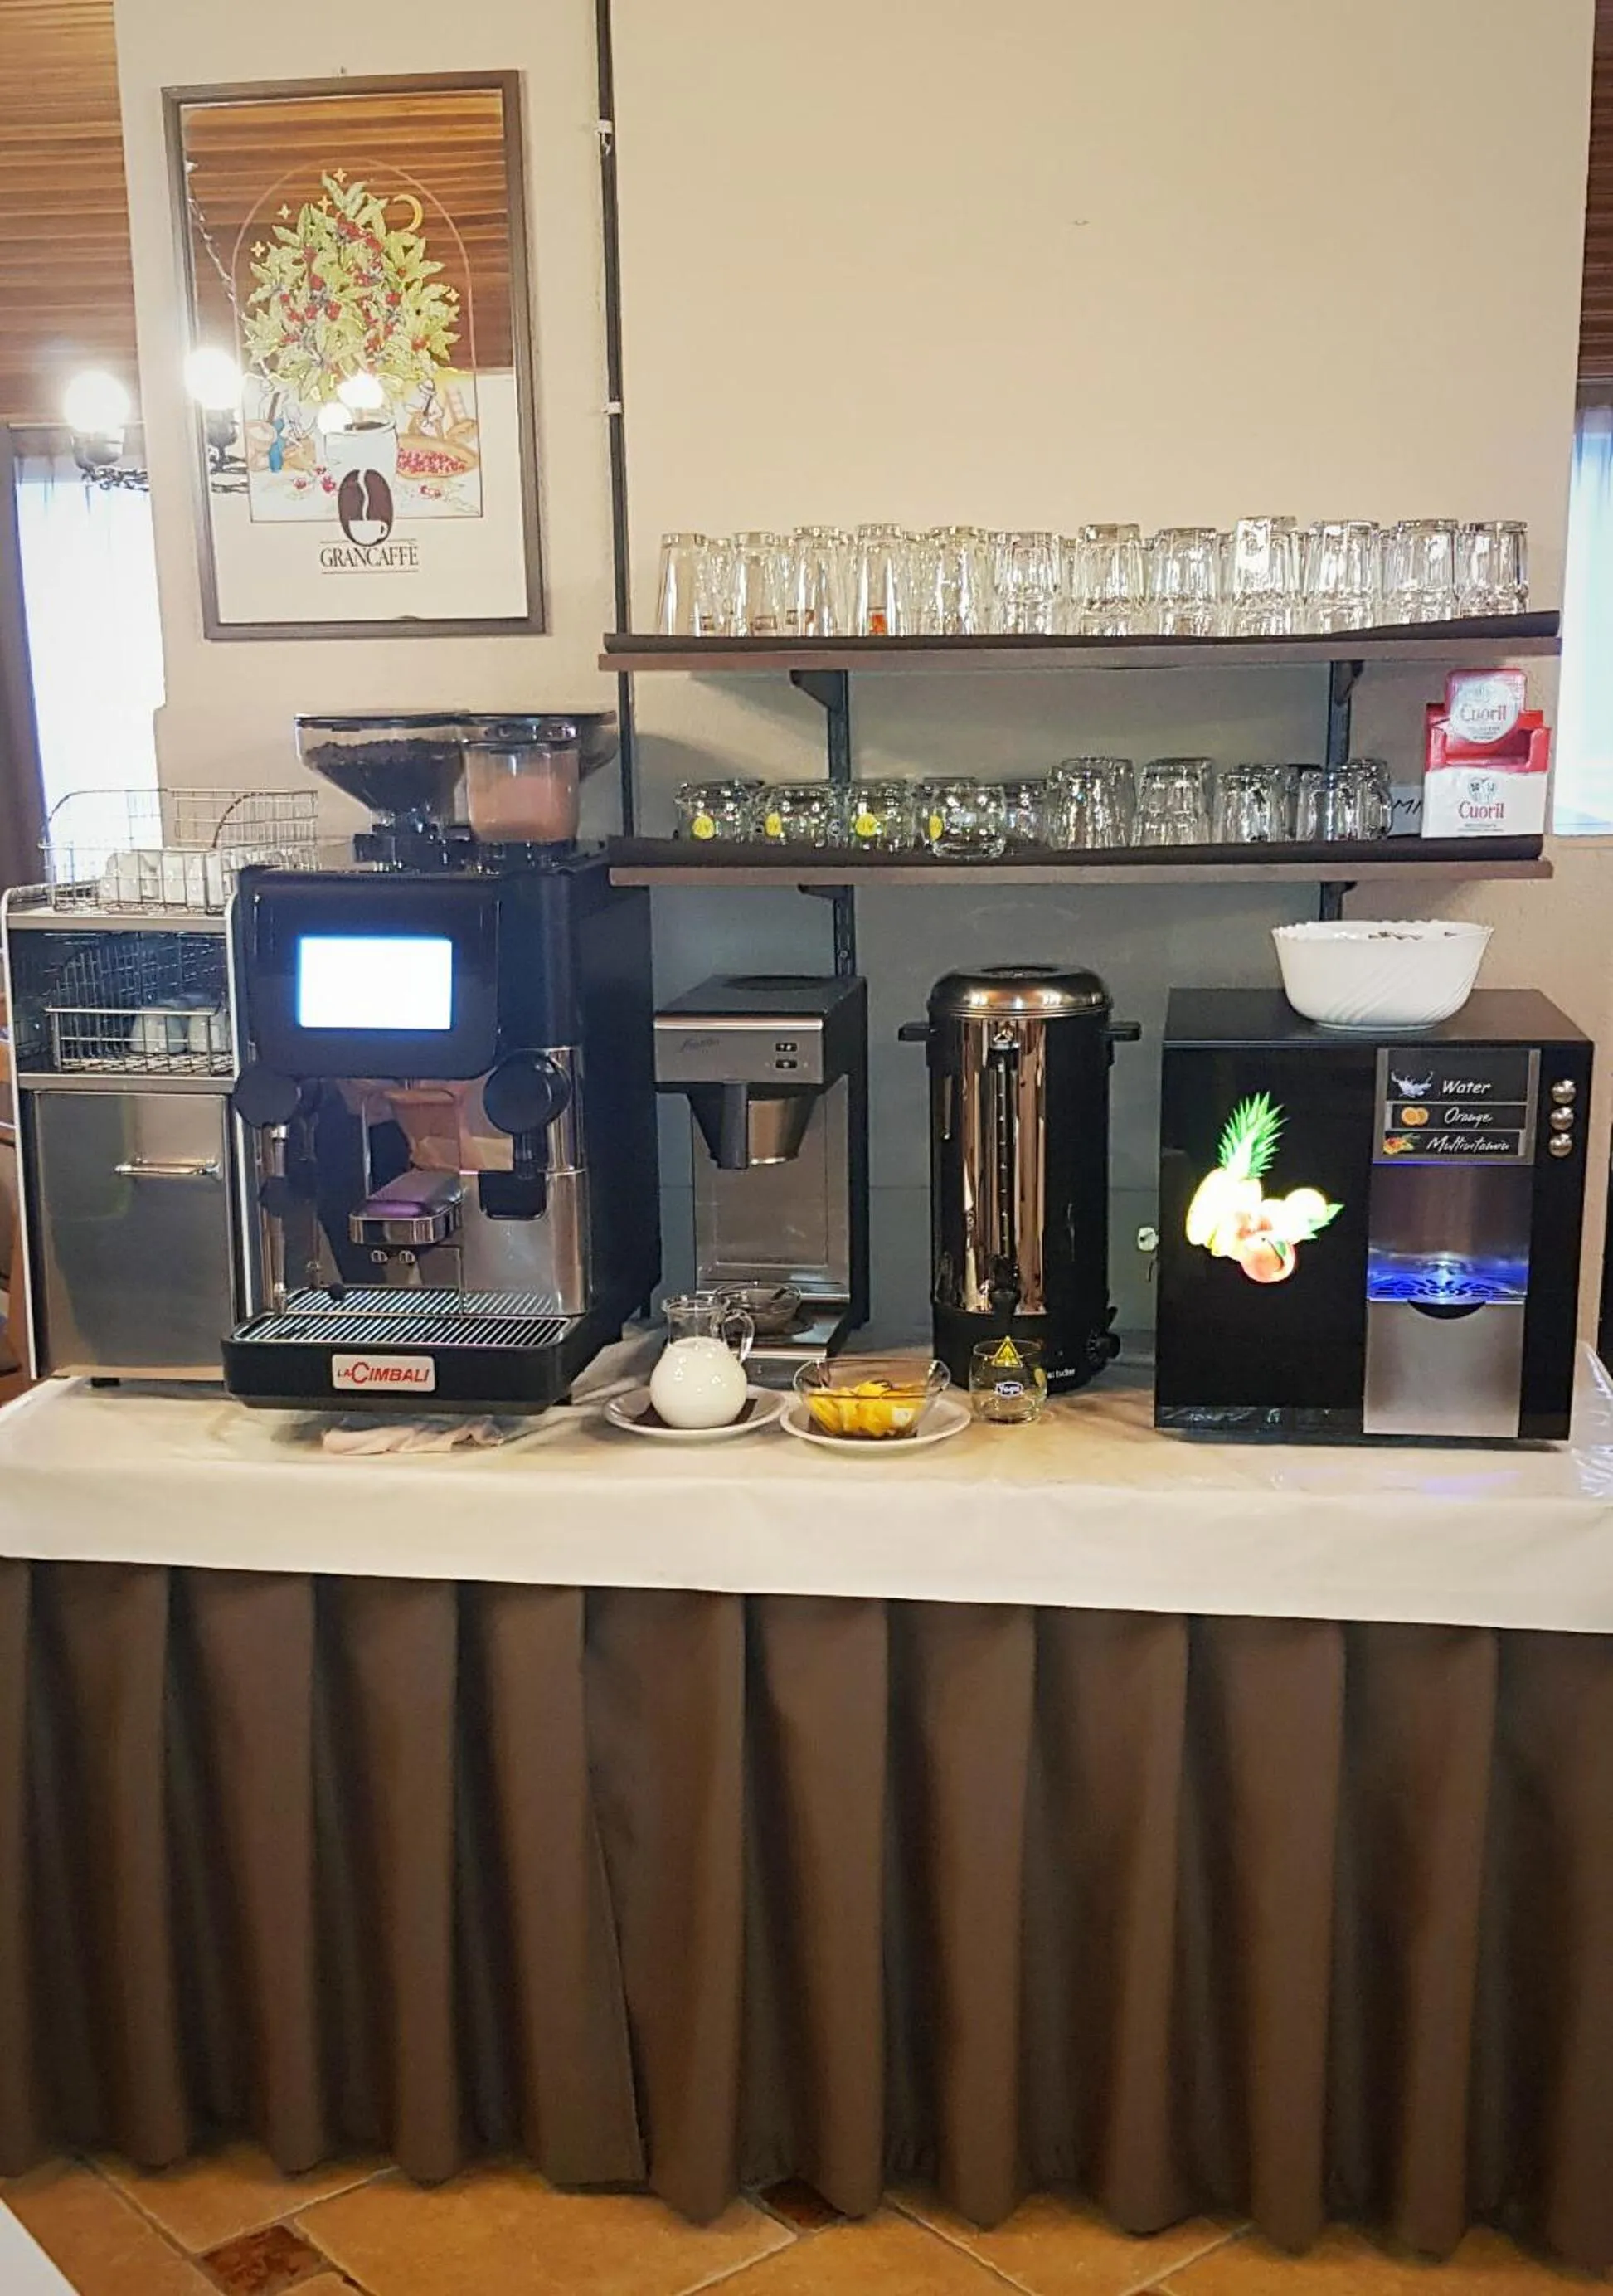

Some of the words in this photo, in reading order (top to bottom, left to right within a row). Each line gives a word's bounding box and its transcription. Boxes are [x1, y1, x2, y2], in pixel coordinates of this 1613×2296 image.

[1460, 704, 1507, 722] Cuoril
[1458, 800, 1505, 820] Cuoril
[1442, 1080, 1492, 1095] Water
[1444, 1106, 1493, 1128] Orange
[1426, 1135, 1510, 1153] Multivitamin
